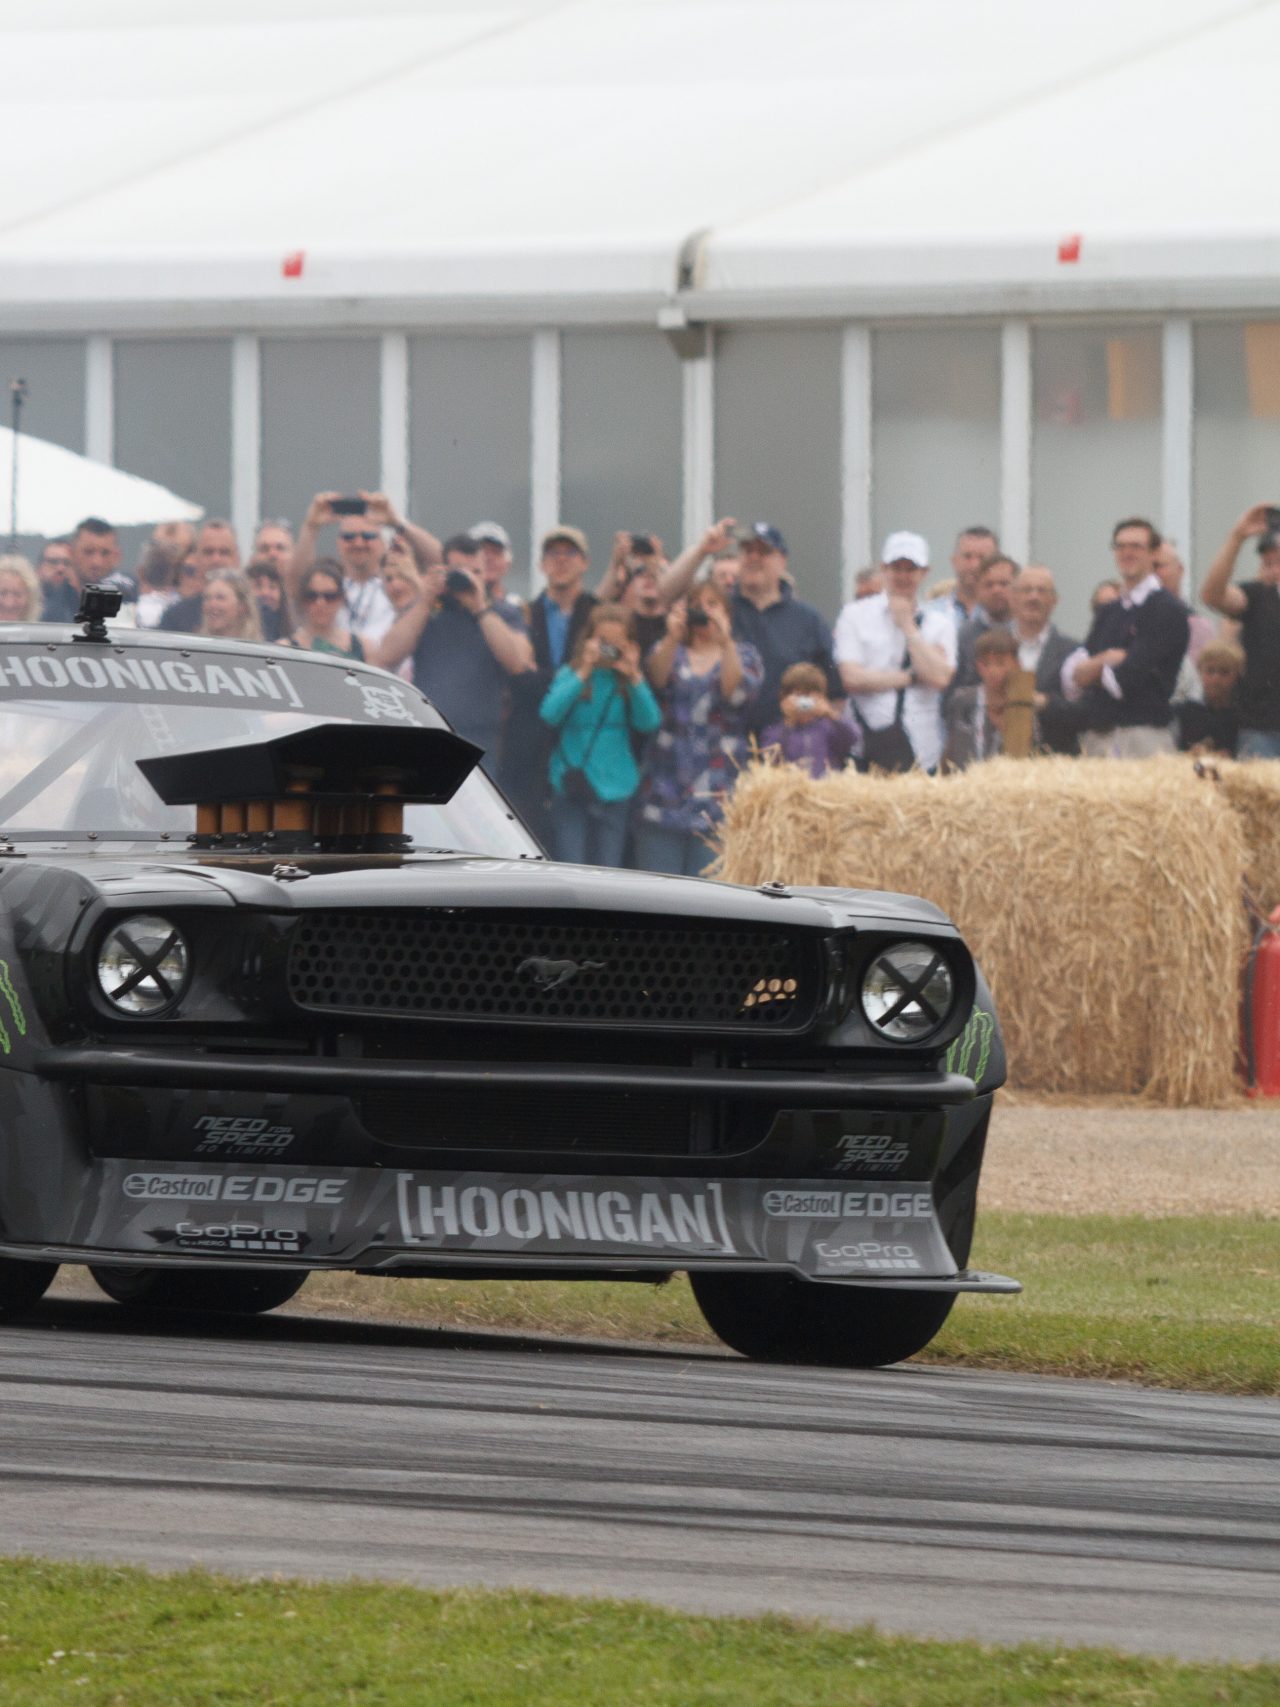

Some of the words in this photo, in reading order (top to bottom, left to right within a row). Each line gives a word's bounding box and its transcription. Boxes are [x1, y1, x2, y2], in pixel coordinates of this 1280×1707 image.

[193, 1116, 269, 1131] NEED
[202, 1131, 296, 1147] SPEED
[835, 1135, 892, 1149] NEED
[840, 1149, 910, 1163] SPEED
[148, 1177, 214, 1196] Castrol
[222, 1175, 349, 1204] EDGE
[783, 1194, 837, 1213] Castrol
[842, 1191, 932, 1217] EDGE
[175, 1222, 299, 1240] GoPro
[815, 1242, 915, 1258] GoPro
